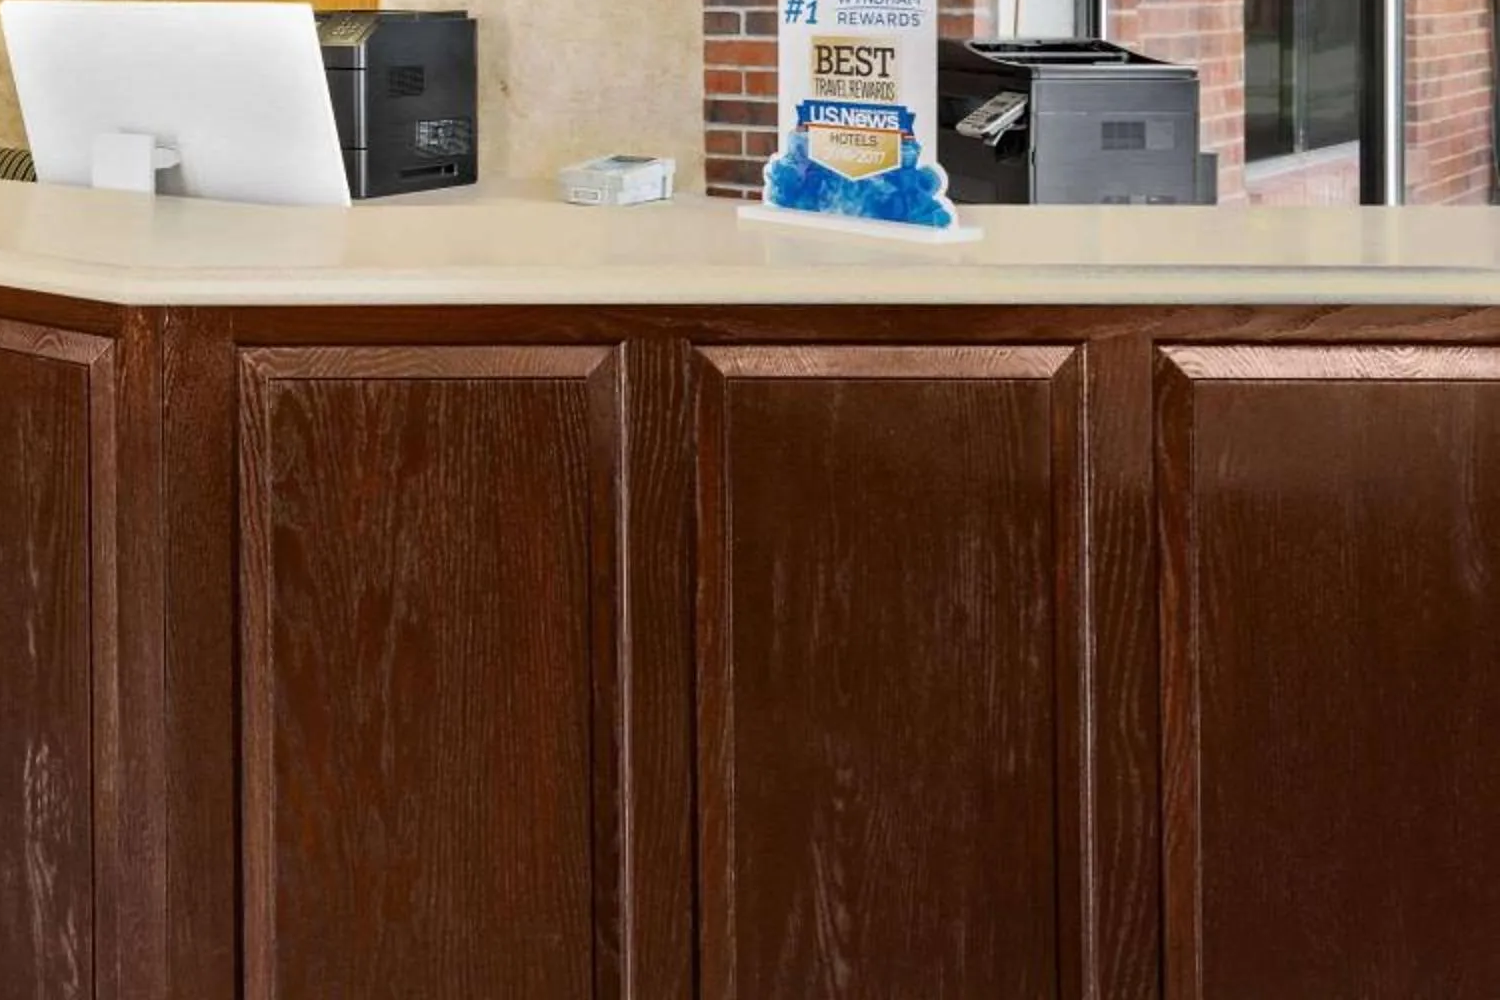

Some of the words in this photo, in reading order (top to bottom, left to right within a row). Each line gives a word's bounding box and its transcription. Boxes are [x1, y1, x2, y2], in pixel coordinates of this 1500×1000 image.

[837, 11, 921, 27] REWARDS
[814, 45, 894, 78] BEST
[815, 78, 847, 98] TRAVEL
[849, 80, 895, 101] REWARDS
[830, 131, 877, 146] HOTELS
